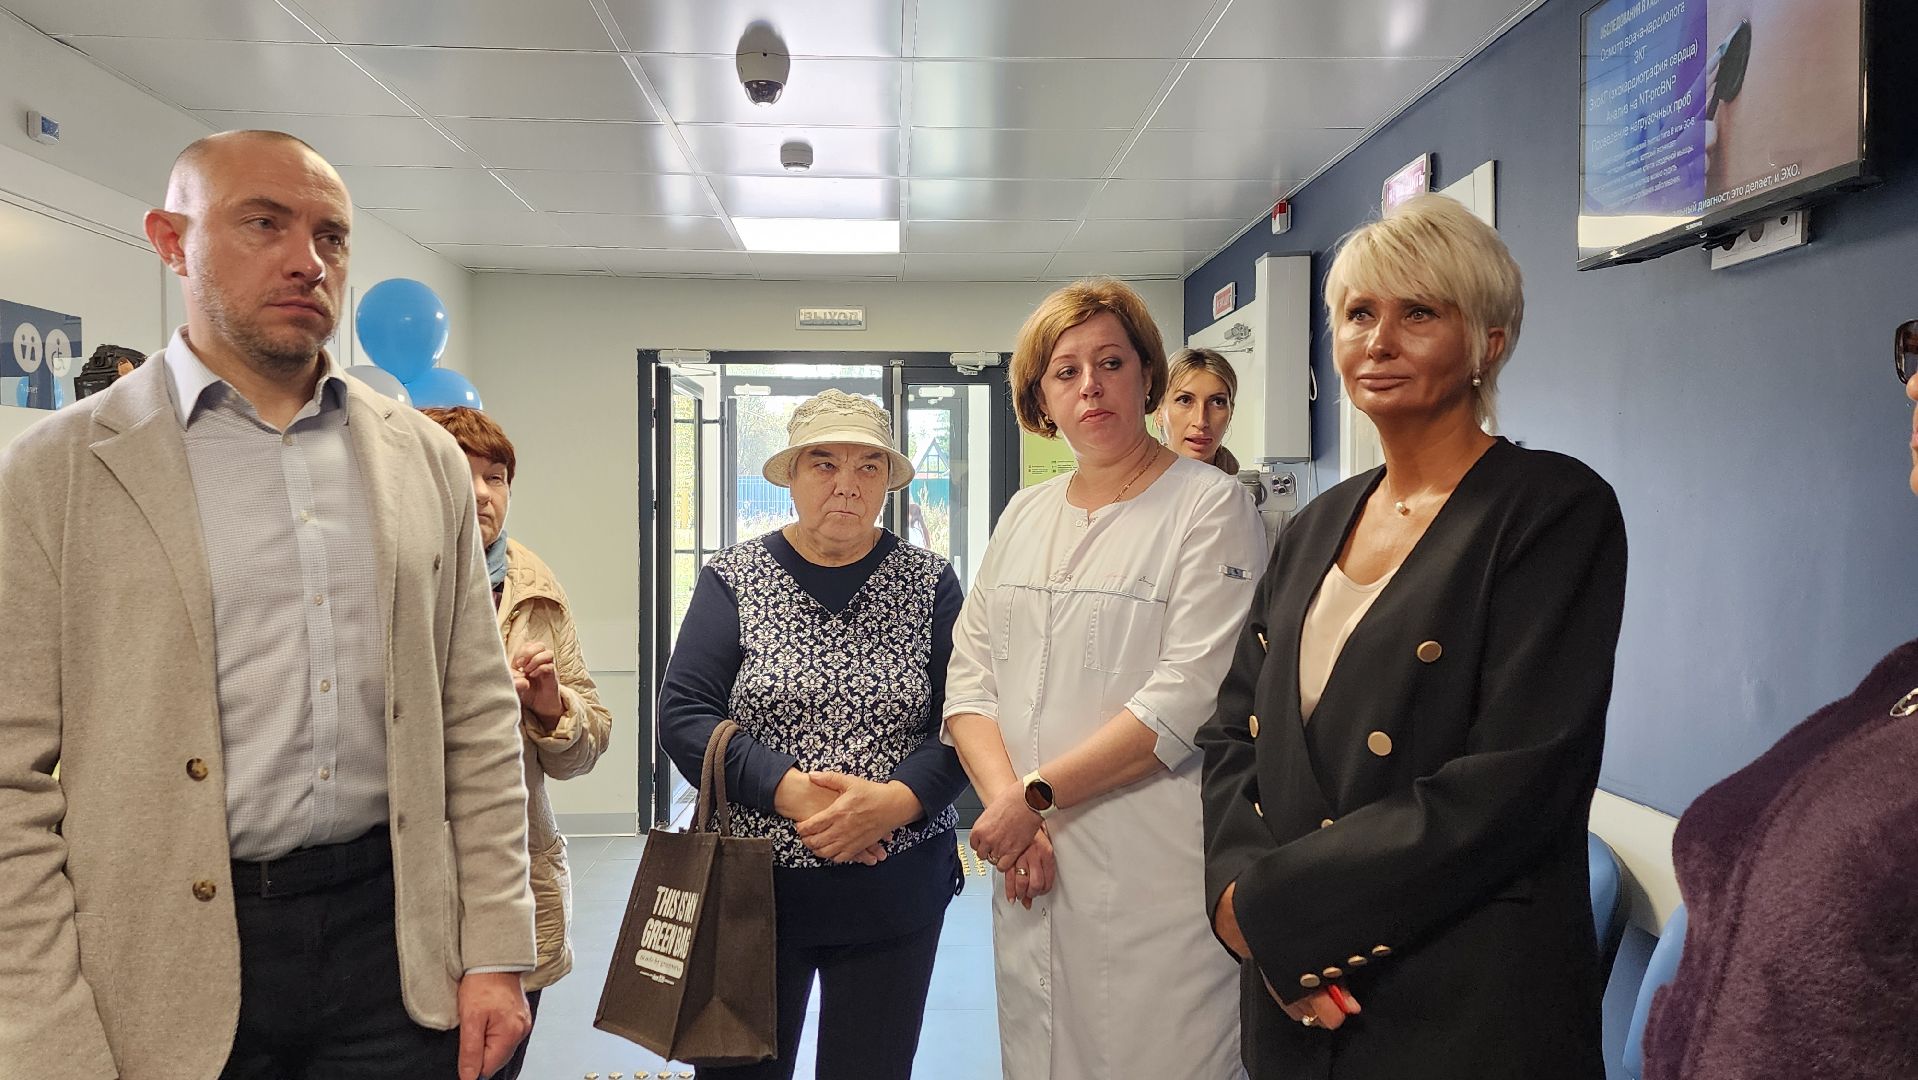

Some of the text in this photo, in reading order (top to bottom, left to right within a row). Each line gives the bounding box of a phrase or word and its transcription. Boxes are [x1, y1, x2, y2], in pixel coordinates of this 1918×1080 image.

[1600, 2, 1685, 62] Осмотр врача-кардиолога
[1634, 45, 1647, 64] ЭКГ
[1669, 39, 1698, 66] сердца)
[1630, 104, 1673, 132] нагрузочных
[1673, 90, 1692, 113] проб
[1731, 188, 1744, 199] это
[1780, 163, 1800, 181] ЭХО.
[653, 885, 700, 924] THIS IS MY
[640, 917, 692, 960] GREEN BAG
